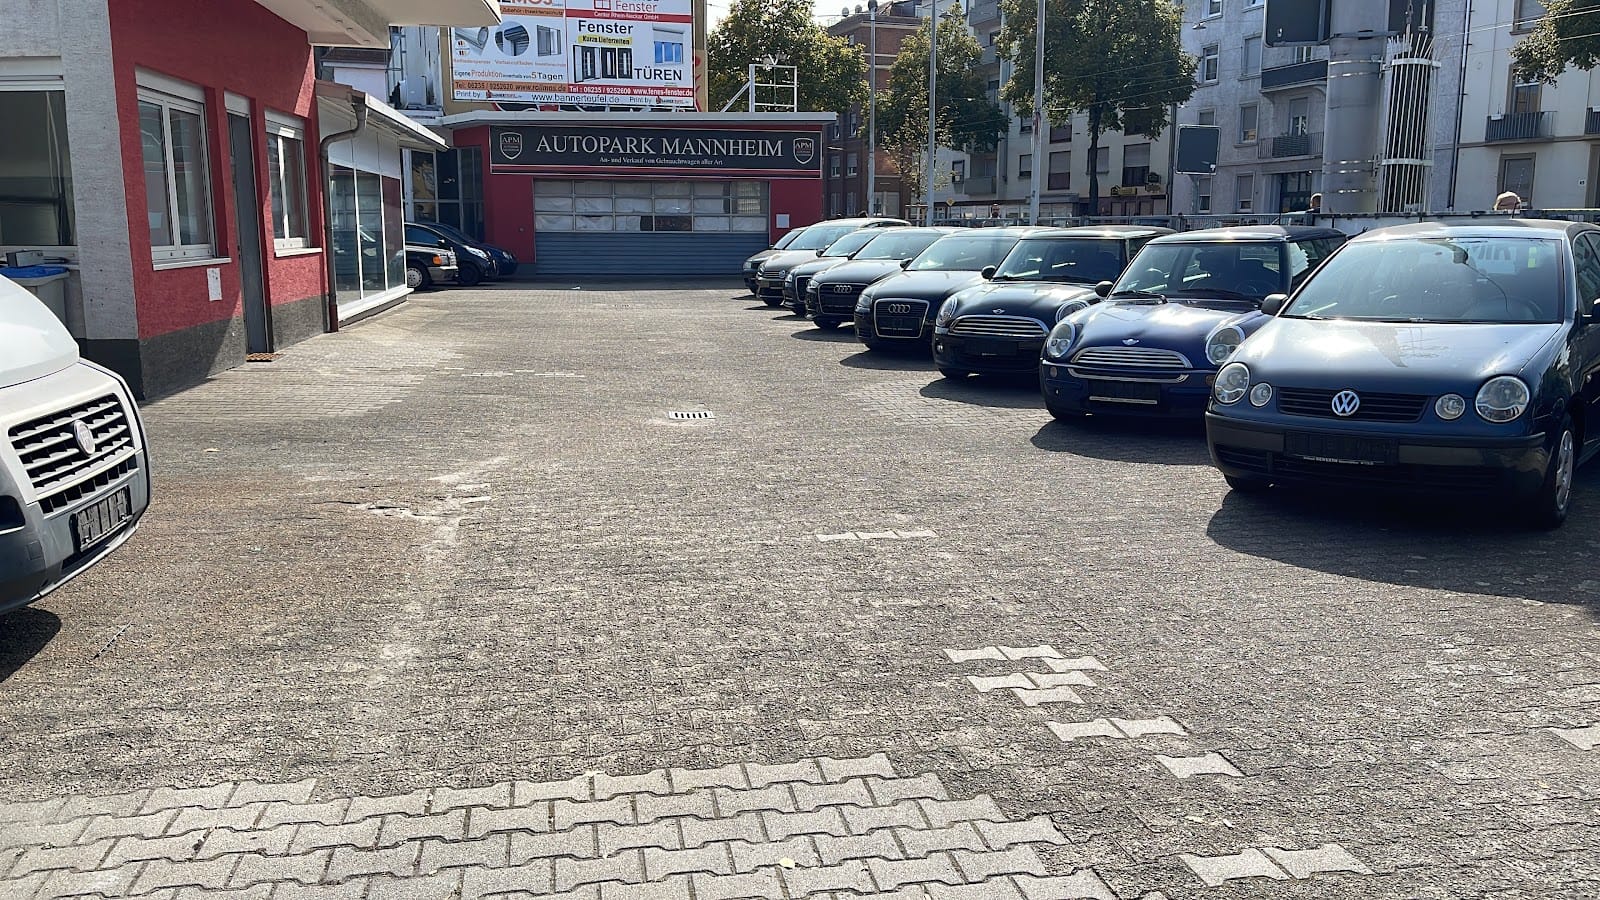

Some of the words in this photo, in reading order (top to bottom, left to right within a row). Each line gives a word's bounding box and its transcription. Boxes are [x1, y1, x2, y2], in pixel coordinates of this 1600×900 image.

[616, 0, 658, 12] Fenster
[578, 20, 633, 34] Fenster
[471, 70, 502, 78] Produktion
[538, 72, 563, 80] Tagen
[634, 66, 682, 80] TÜREN
[532, 93, 620, 103] www.bannerteufel.de
[536, 135, 656, 154] AUTOPARK
[661, 138, 784, 157] MANNHEIM
